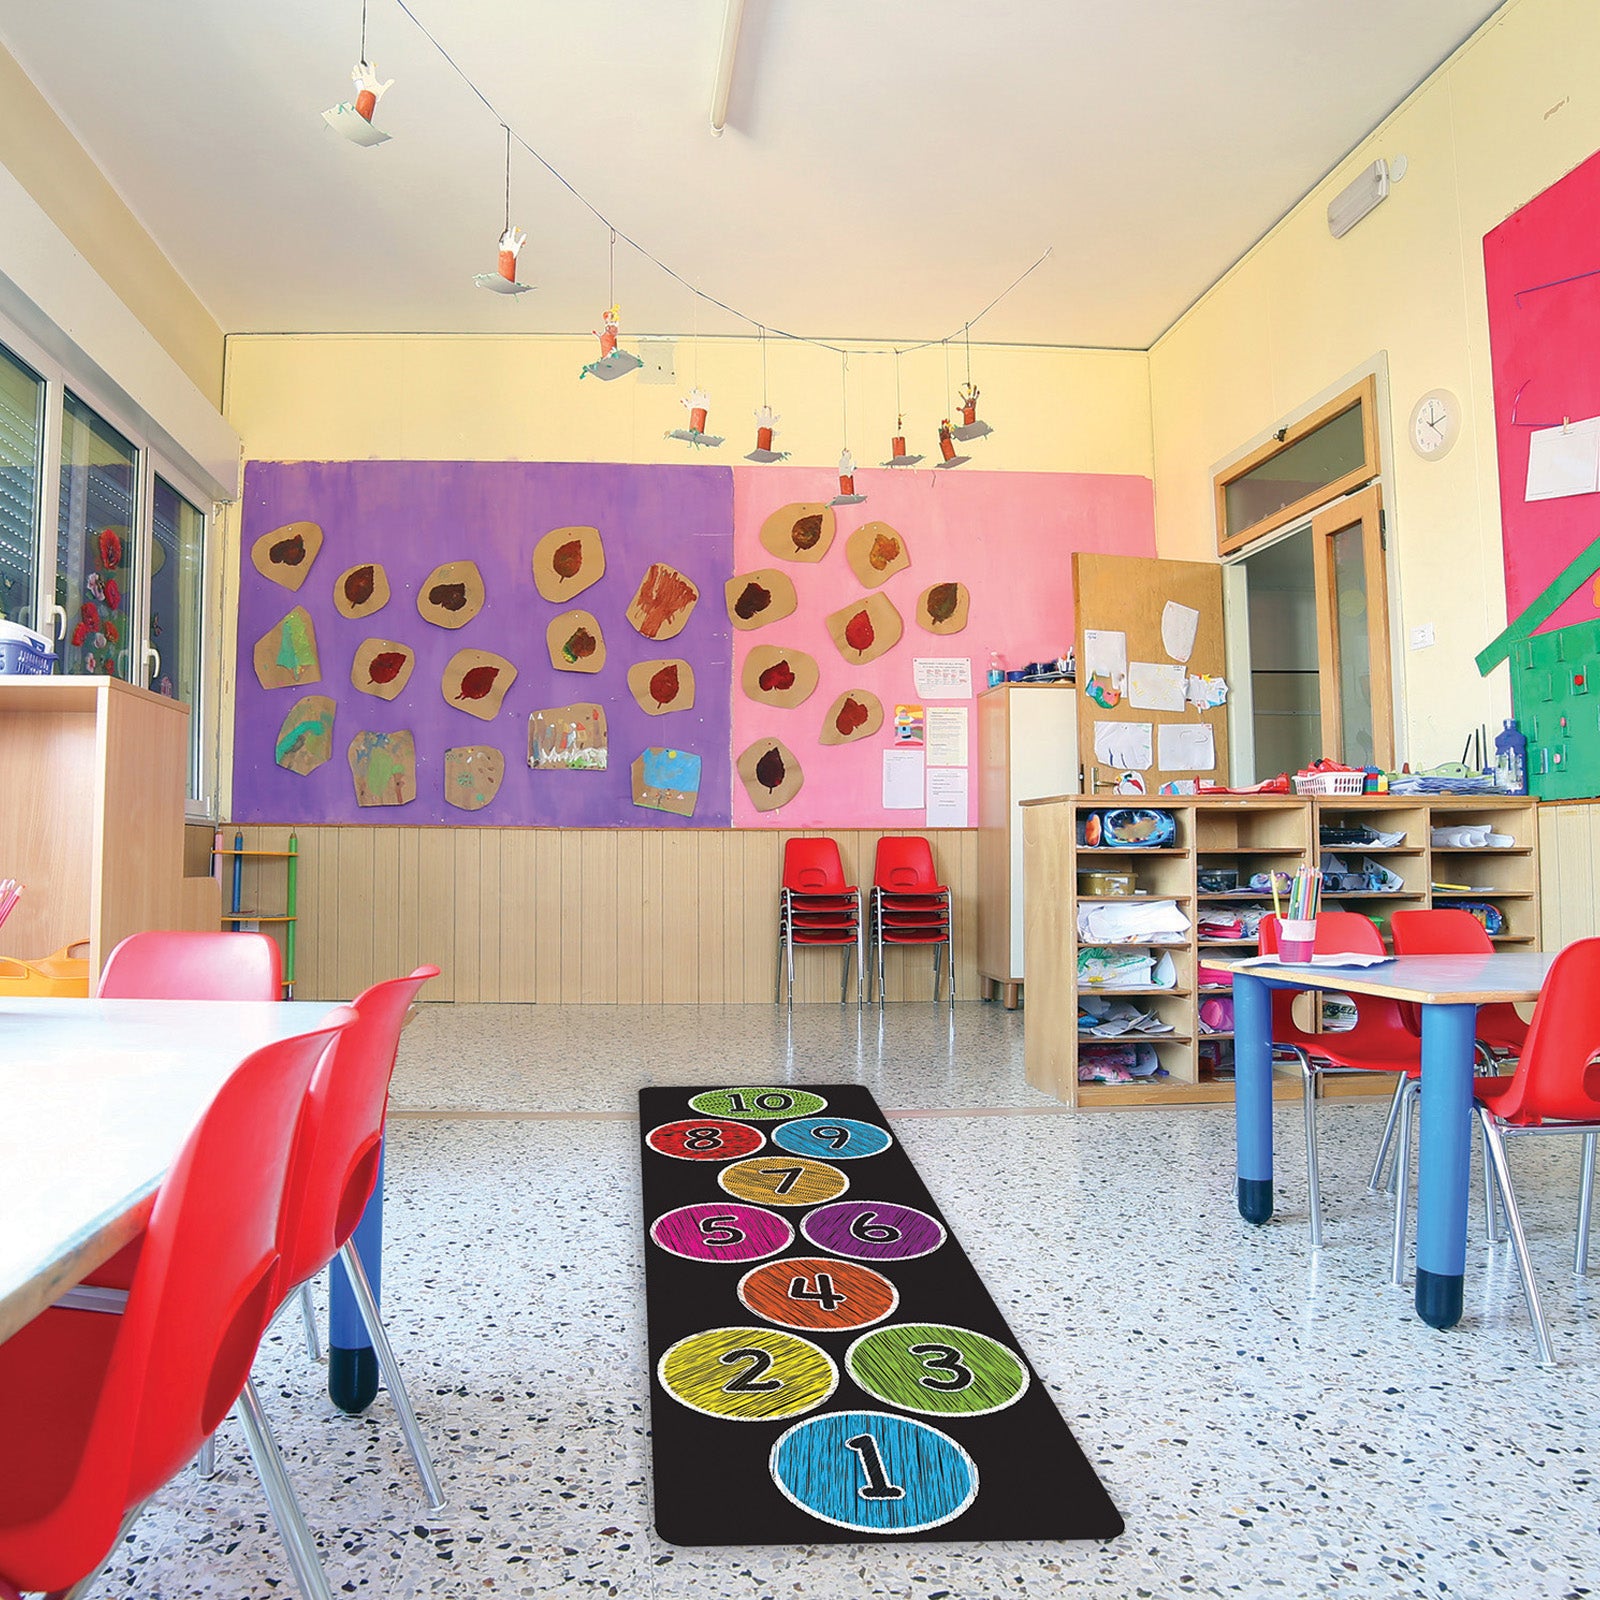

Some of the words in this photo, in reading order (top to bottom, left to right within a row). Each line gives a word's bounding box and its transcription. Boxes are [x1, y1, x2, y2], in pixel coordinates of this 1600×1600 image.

[727, 1093, 793, 1113] 10
[685, 1128, 725, 1151] 8
[811, 1126, 851, 1149] 9
[758, 1167, 803, 1195] 7
[699, 1216, 747, 1246] 5
[850, 1211, 902, 1244] 6
[787, 1273, 847, 1312] 4
[719, 1347, 784, 1393] 2
[908, 1342, 974, 1393] 3
[844, 1433, 906, 1500] 1
